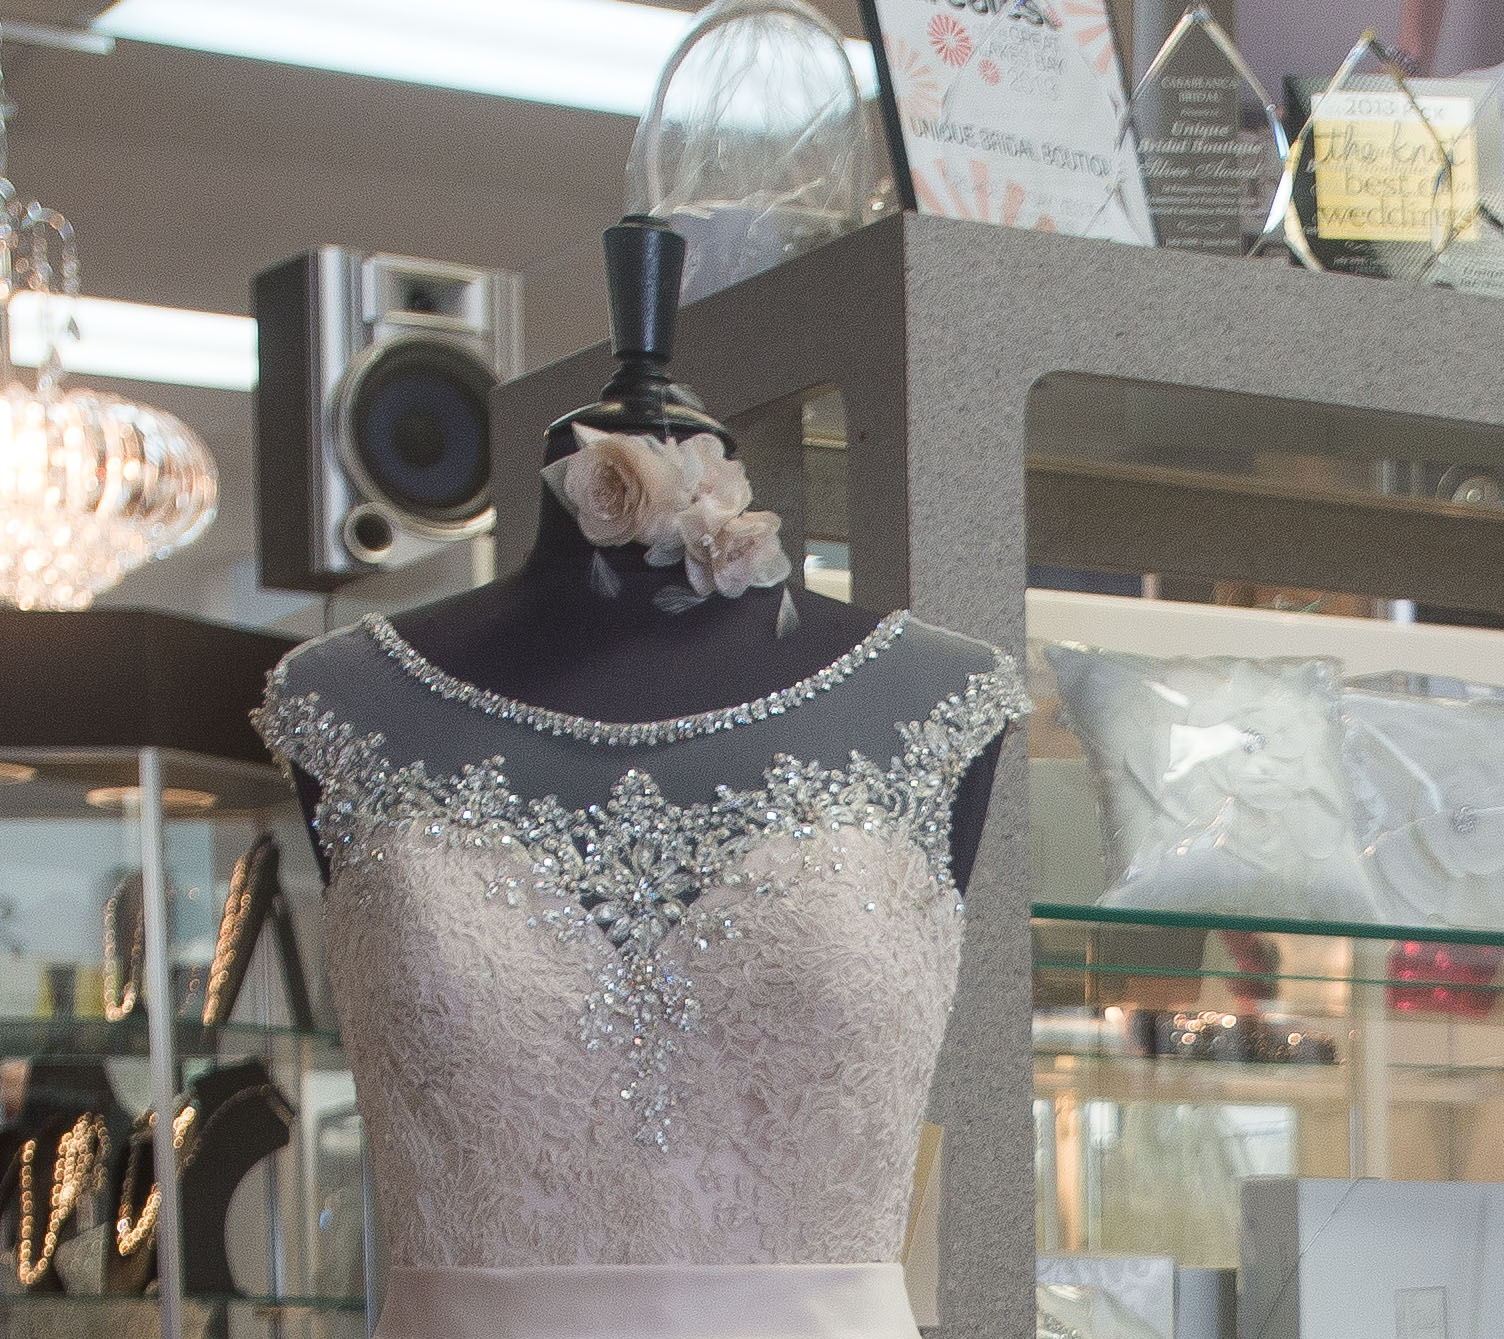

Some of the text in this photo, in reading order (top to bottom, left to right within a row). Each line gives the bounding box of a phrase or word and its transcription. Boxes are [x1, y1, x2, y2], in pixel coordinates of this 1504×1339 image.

[1344, 97, 1396, 116] 2013
[1171, 120, 1231, 140] Unique
[1191, 138, 1264, 155] Boutique
[1315, 123, 1377, 165] the
[1345, 169, 1410, 197] best
